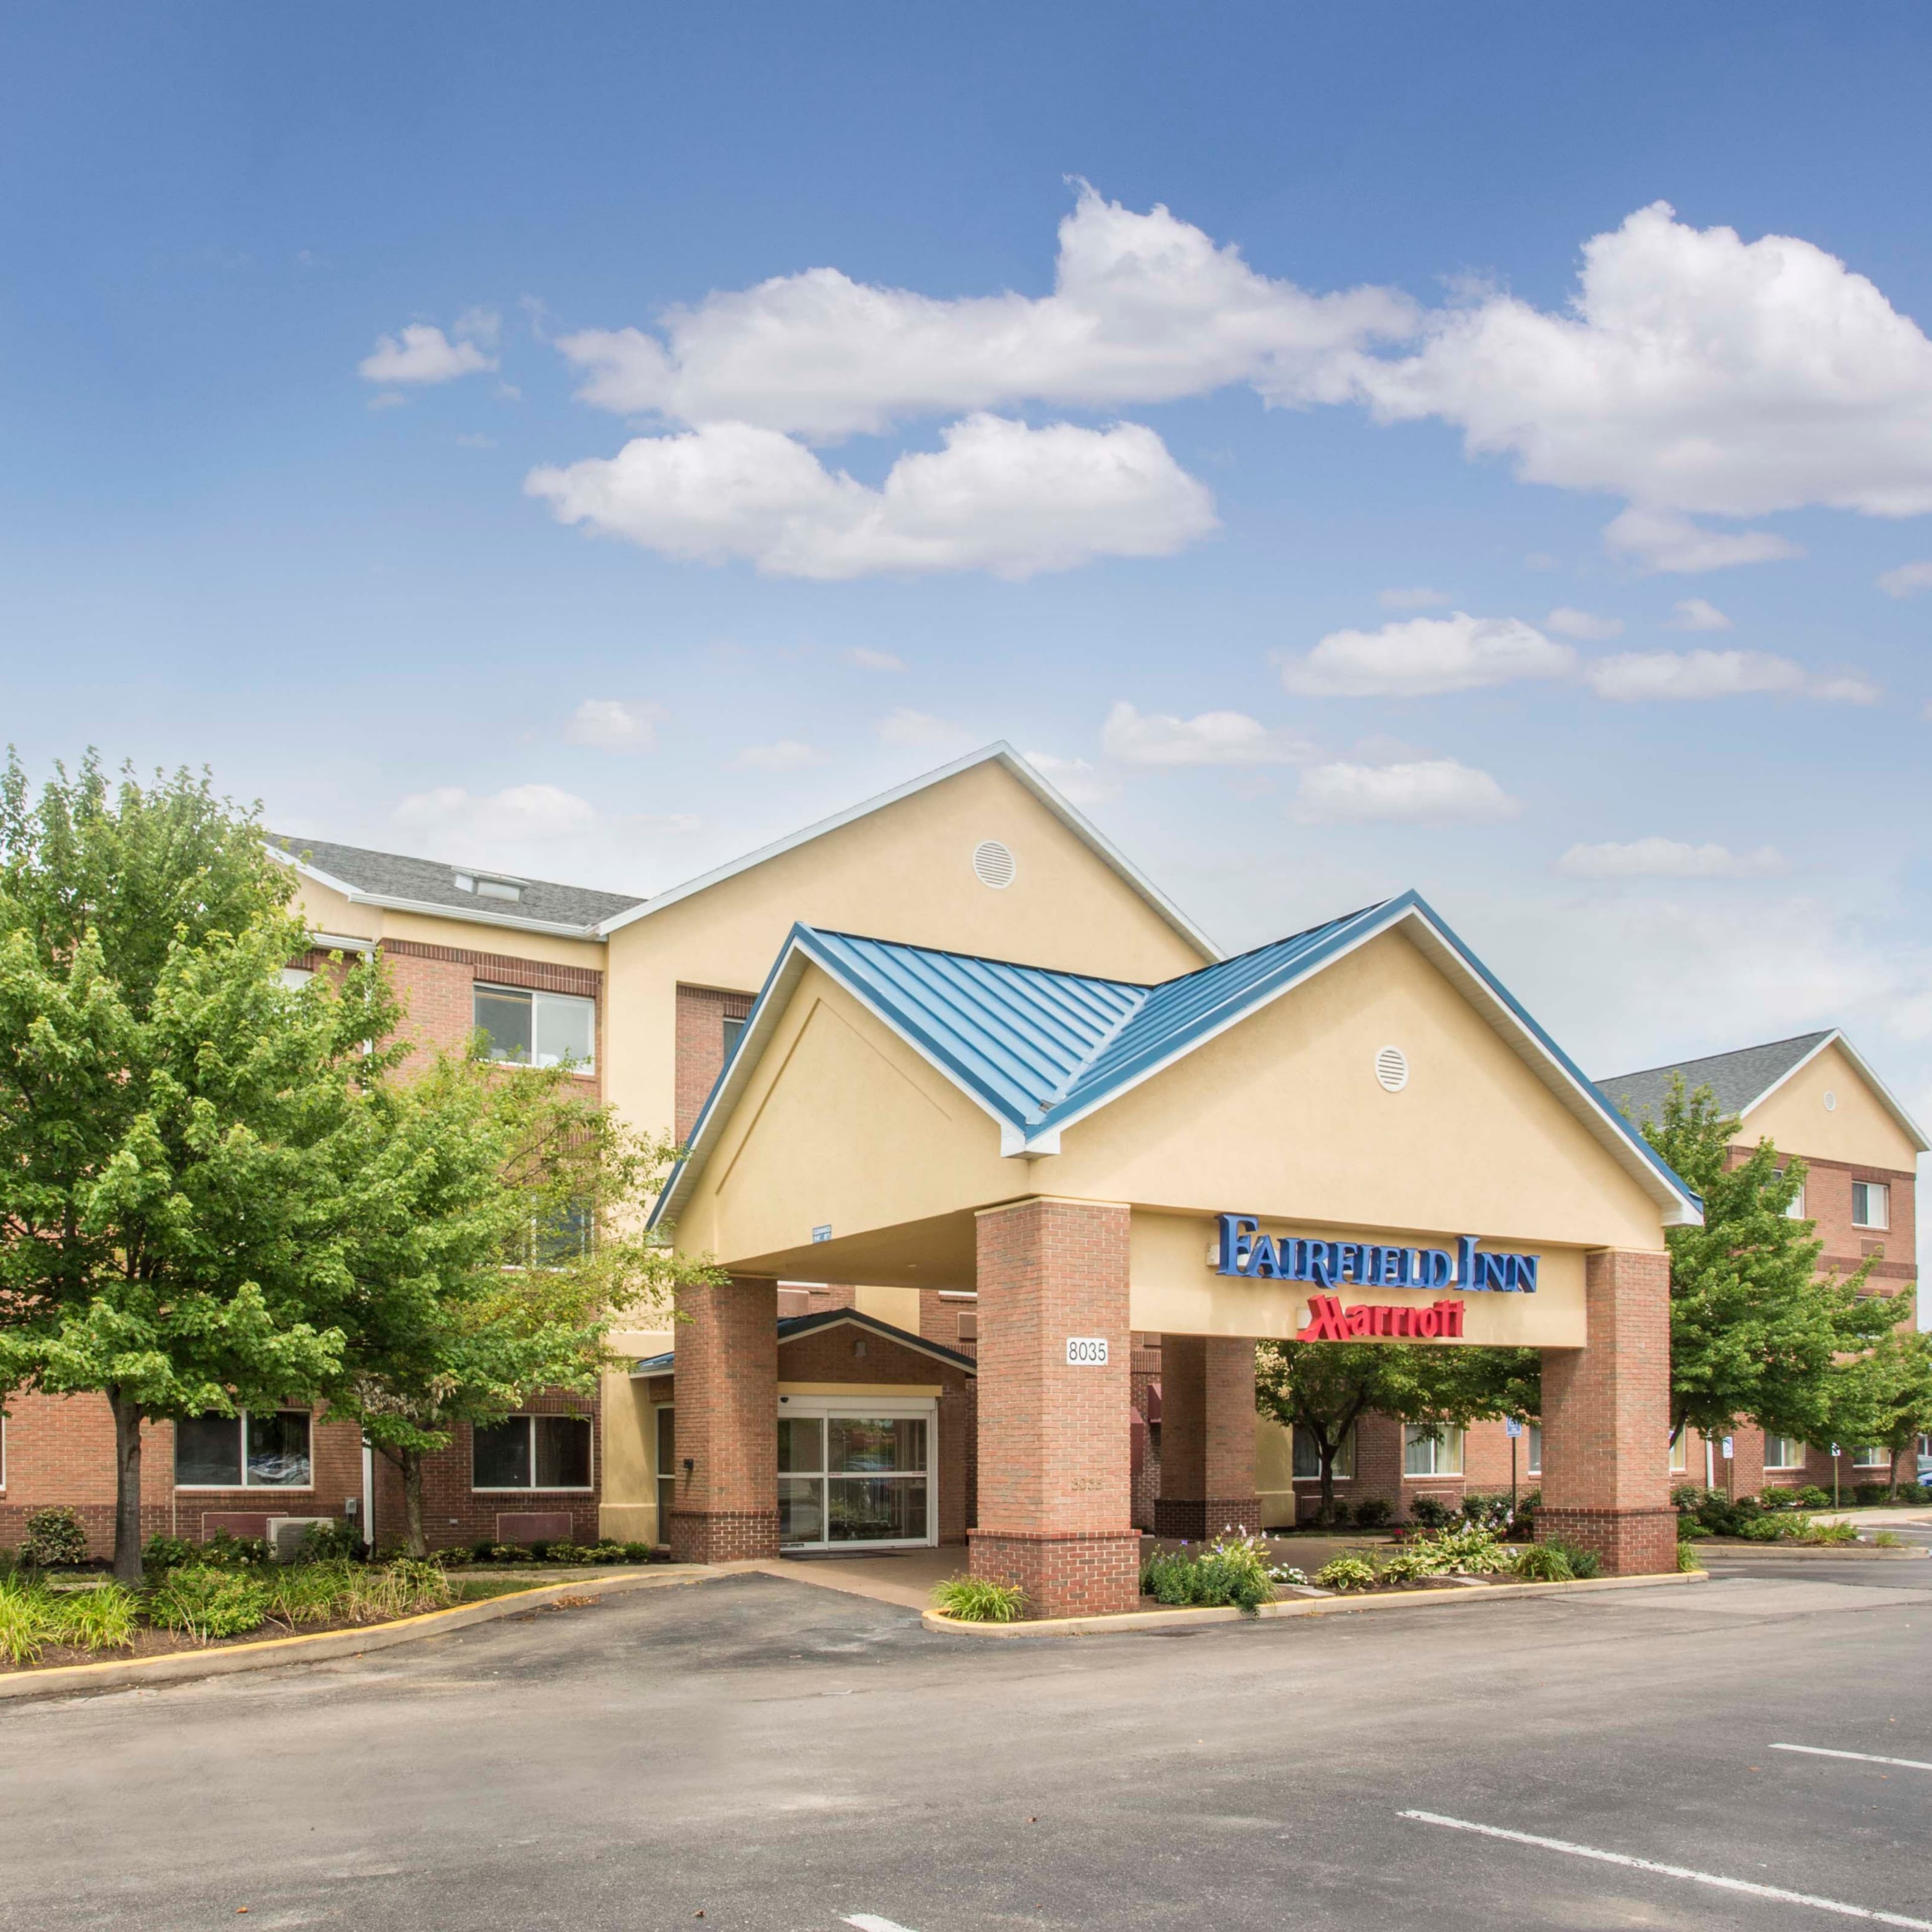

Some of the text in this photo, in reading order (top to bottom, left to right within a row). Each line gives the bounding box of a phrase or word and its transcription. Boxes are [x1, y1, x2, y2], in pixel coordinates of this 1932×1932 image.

[1216, 1213, 1540, 1293] FAIRFIELD INN
[1296, 1294, 1464, 1342] Marriott
[1069, 1341, 1106, 1361] 8035
